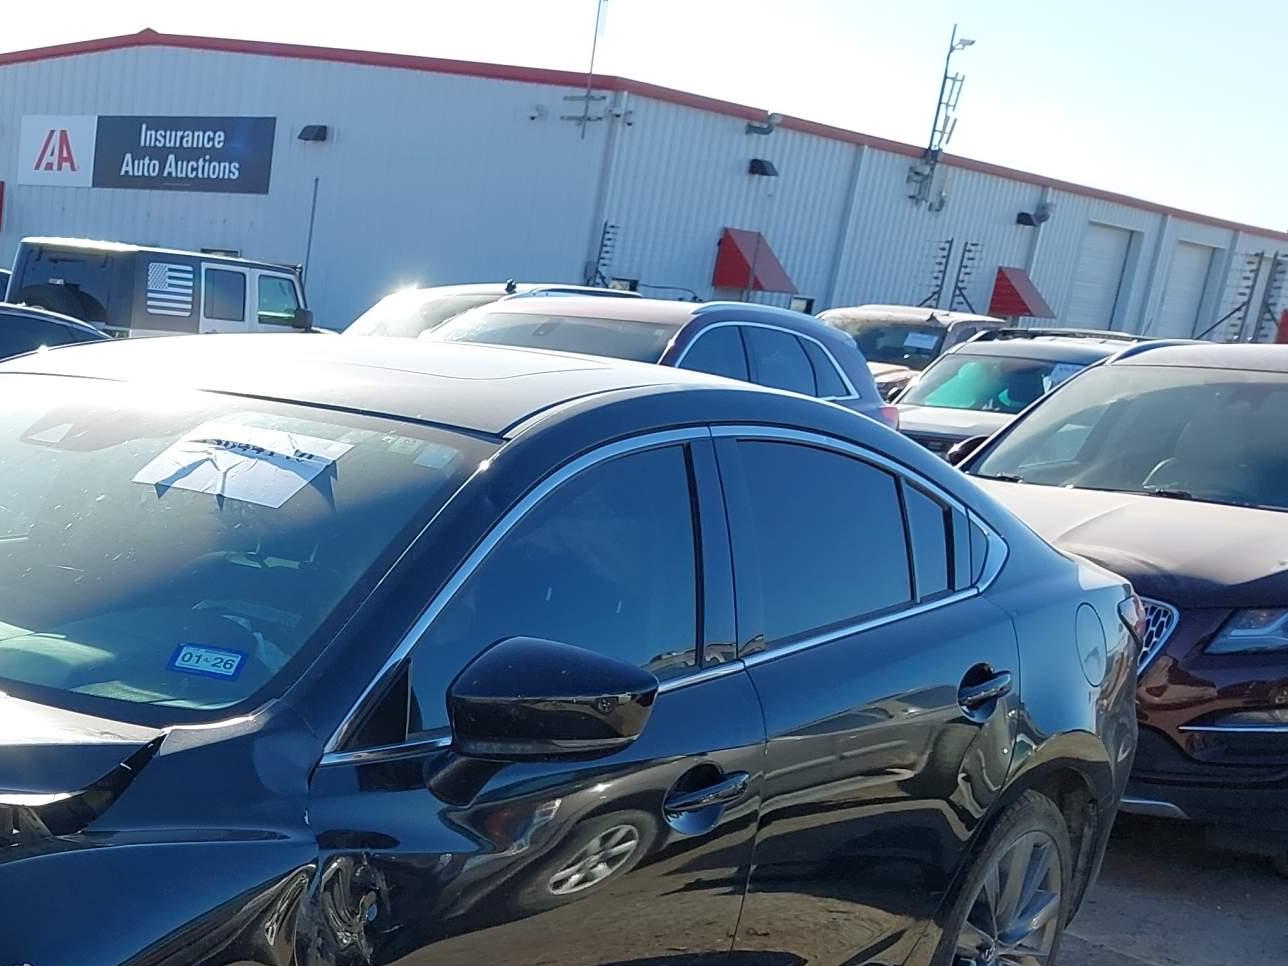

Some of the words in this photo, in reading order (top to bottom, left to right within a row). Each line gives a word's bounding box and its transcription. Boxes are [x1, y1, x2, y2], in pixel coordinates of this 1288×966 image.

[139, 122, 225, 149] Insurance
[119, 152, 160, 178] Auto
[162, 153, 240, 180] Auctions
